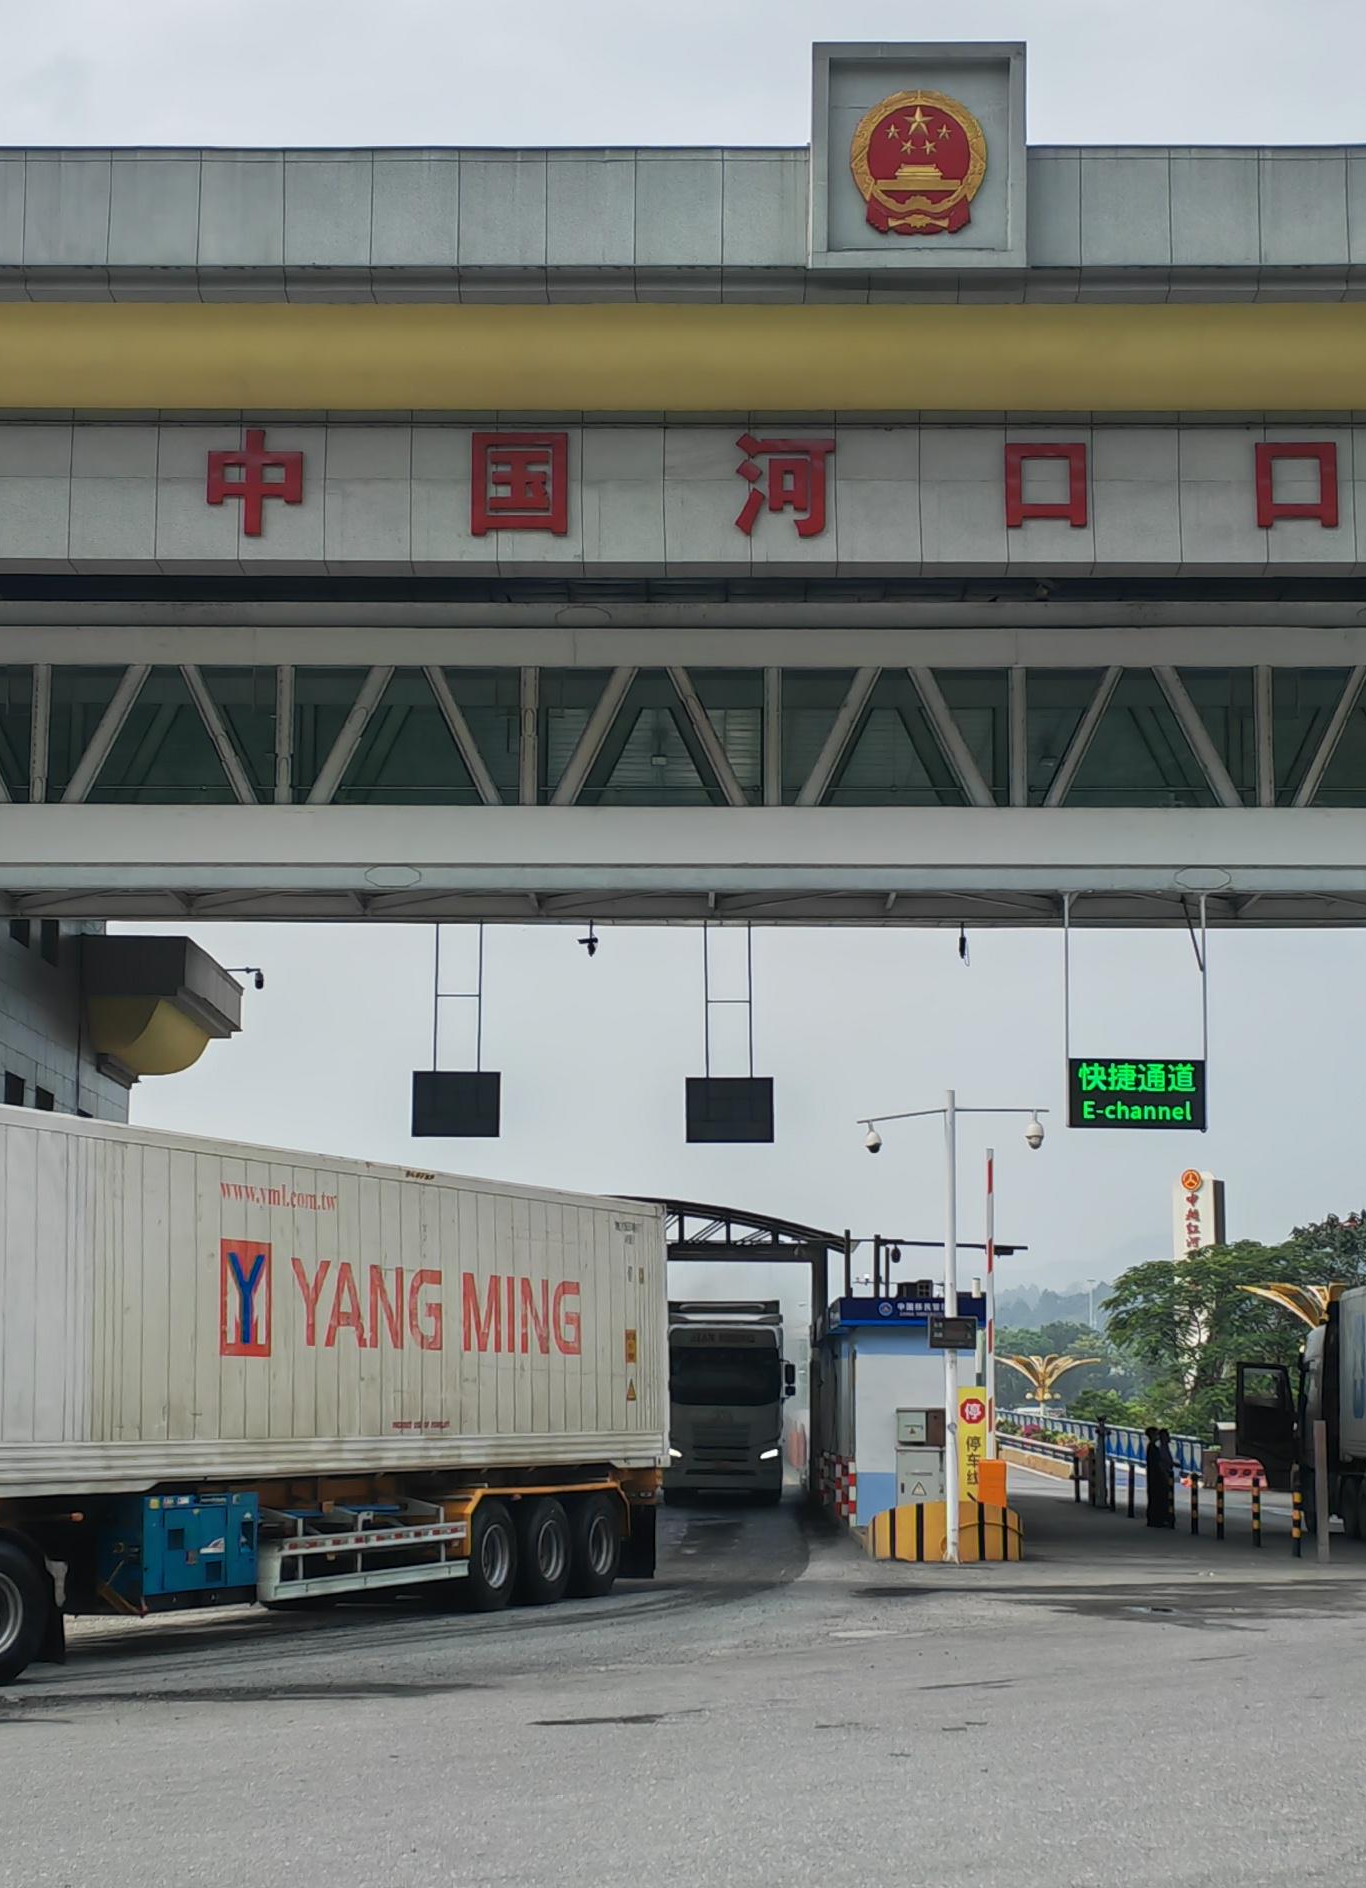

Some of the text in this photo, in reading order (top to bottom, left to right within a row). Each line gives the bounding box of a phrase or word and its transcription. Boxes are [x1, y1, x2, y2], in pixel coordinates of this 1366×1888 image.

[1078, 1063, 1196, 1092] 快捷通道
[1082, 1100, 1192, 1121] E-channel
[219, 1182, 337, 1211] www.yml.com.tw
[290, 1256, 443, 1351] YANG
[462, 1271, 582, 1356] MING
